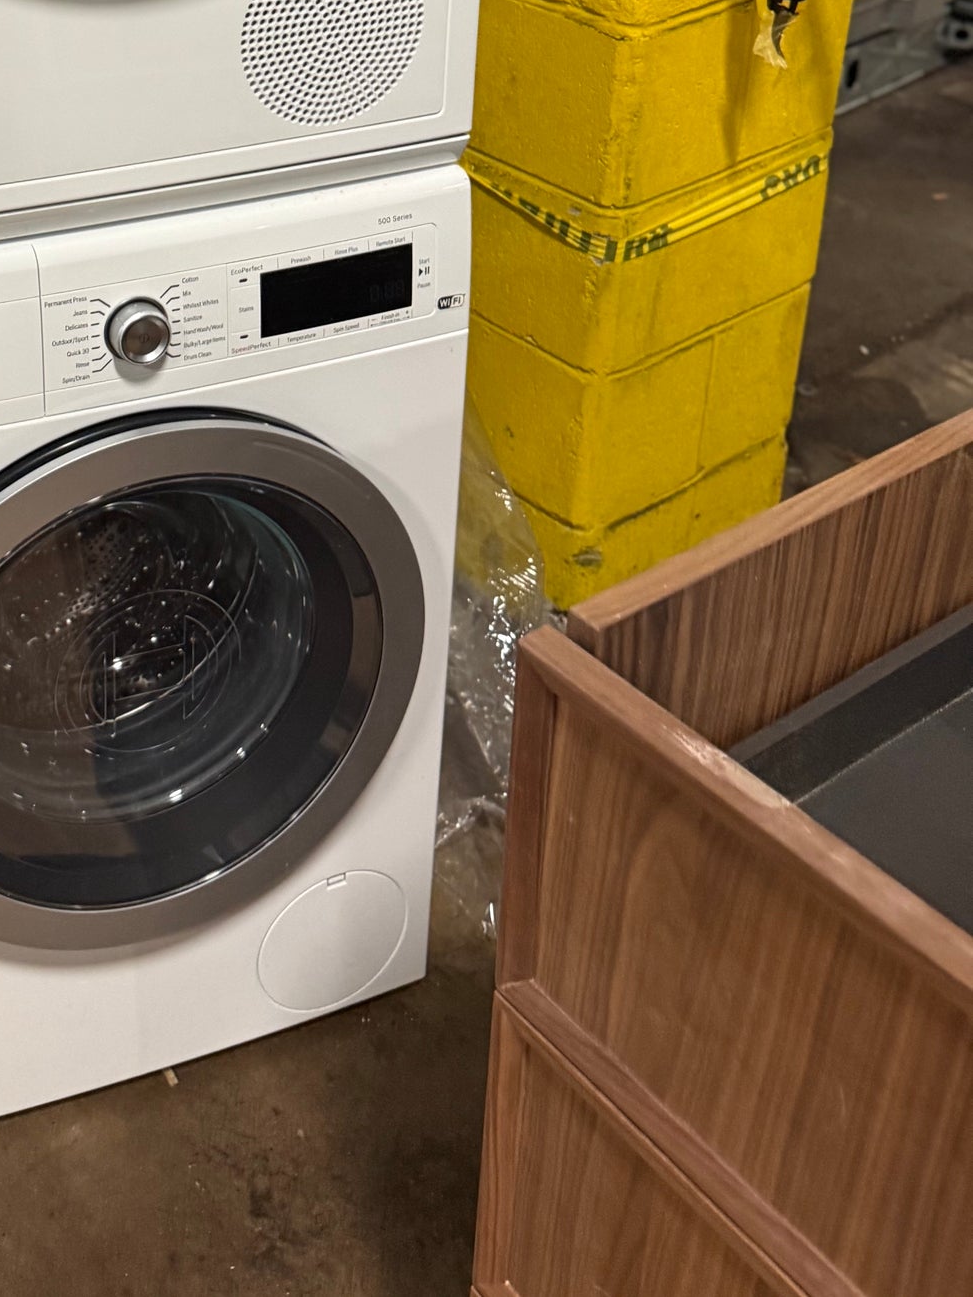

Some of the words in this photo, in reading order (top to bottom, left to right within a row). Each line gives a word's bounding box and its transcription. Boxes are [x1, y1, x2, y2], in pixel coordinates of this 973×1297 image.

[378, 216, 391, 225] 500
[393, 213, 413, 222] Series
[394, 236, 406, 244] Start
[231, 264, 263, 276] EcoPerfect
[44, 298, 72, 308] Permanent
[65, 323, 88, 331] Delicates
[52, 335, 89, 346] Outdoor/Sport
[287, 333, 316, 342] Temperature
[231, 341, 271, 354] SpeedPerfect
